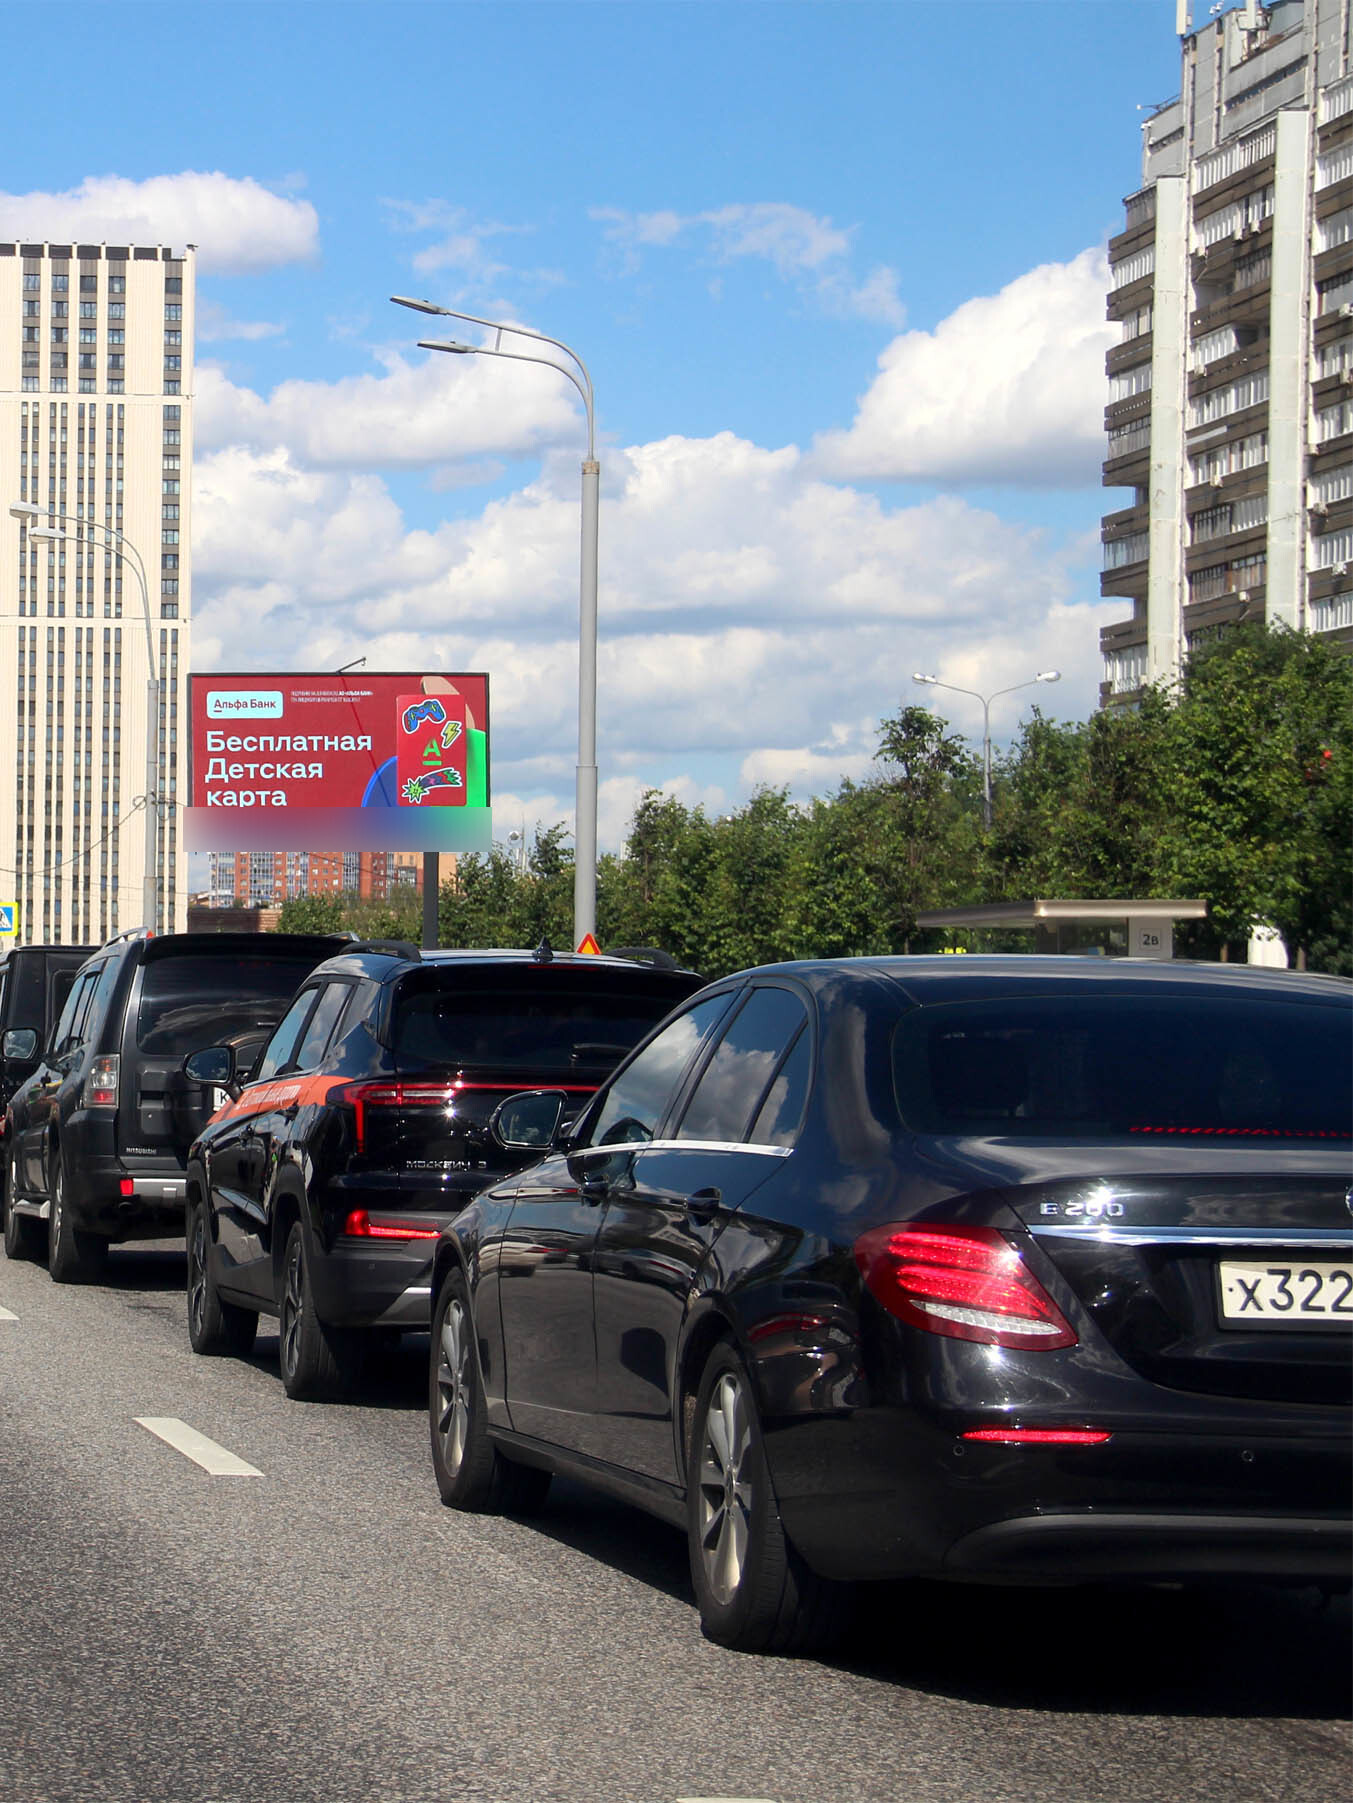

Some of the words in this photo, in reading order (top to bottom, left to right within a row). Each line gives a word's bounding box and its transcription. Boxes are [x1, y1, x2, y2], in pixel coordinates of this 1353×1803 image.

[213, 699, 248, 711] Альфа
[250, 699, 277, 709] Банк
[206, 731, 372, 752] Бесплатная
[204, 758, 324, 783] Детская
[207, 789, 287, 807] карта
[406, 1160, 471, 1169] МОСКВИЧ
[1040, 1203, 1058, 1215] E
[1065, 1202, 1124, 1216] 200
[1236, 1269, 1353, 1312] Х322
